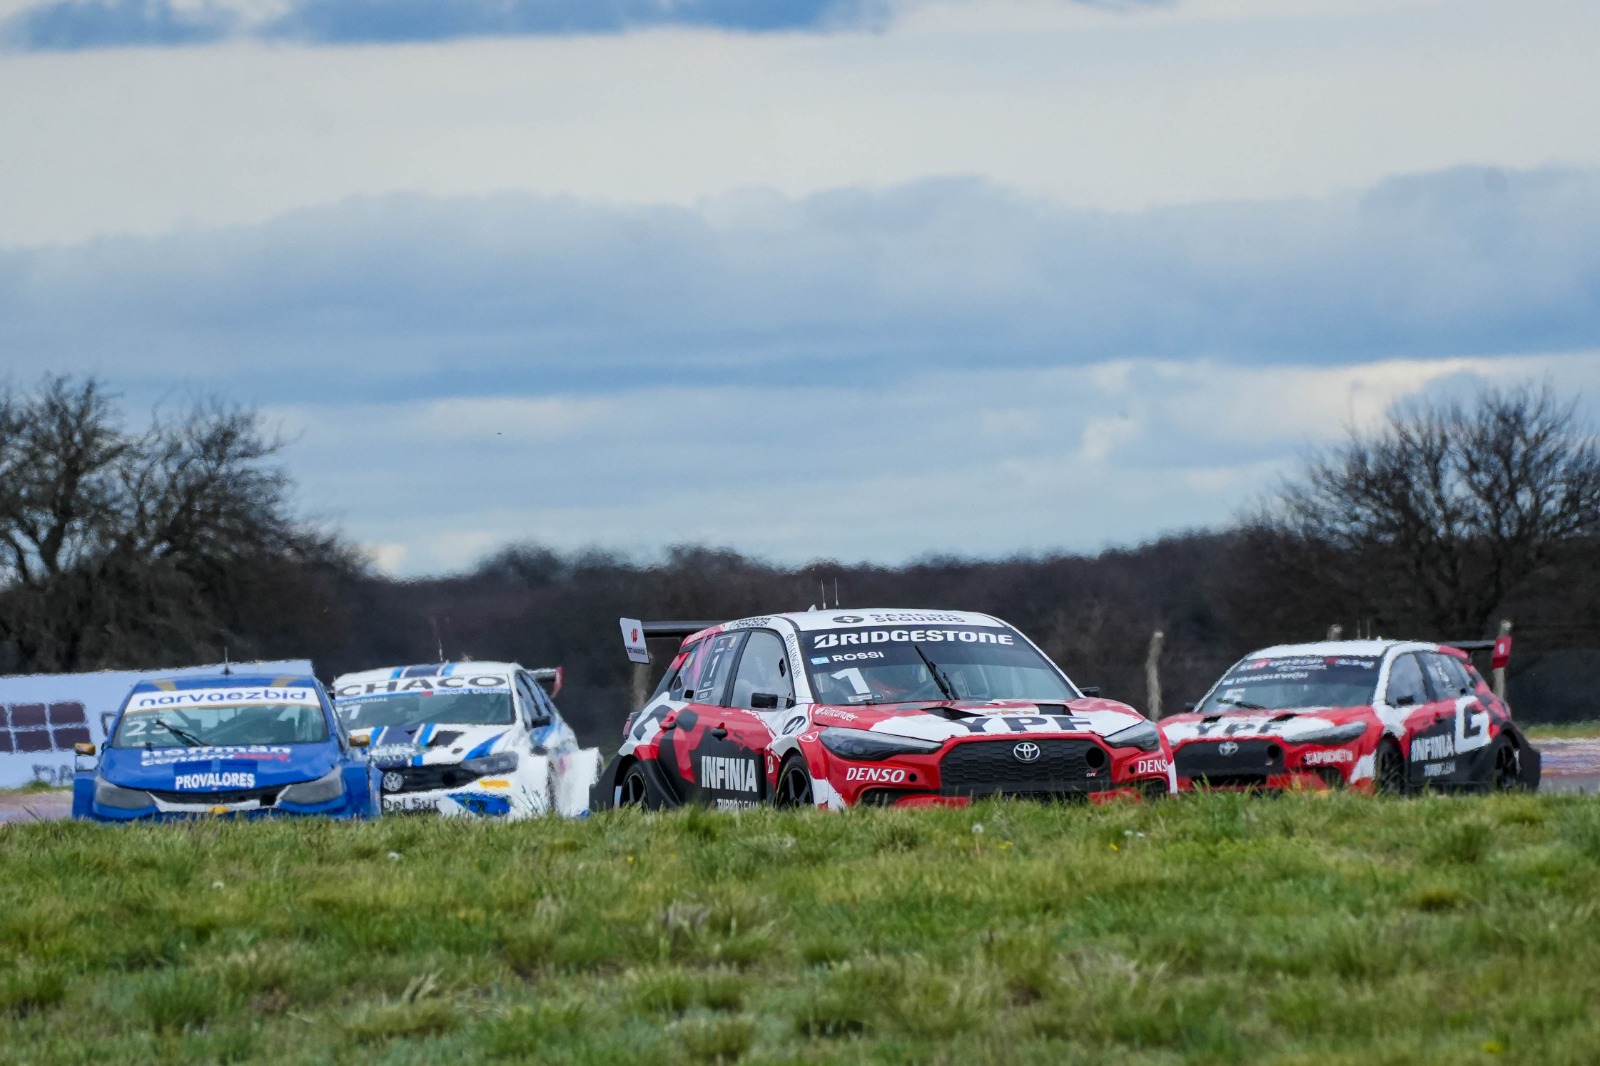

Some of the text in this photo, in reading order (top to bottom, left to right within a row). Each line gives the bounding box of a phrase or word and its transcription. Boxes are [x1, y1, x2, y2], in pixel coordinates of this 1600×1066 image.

[814, 629, 1015, 649] BRIDGESTONE
[832, 651, 885, 663] ROSSI
[336, 676, 507, 697] CHACO
[831, 667, 870, 695] 1
[139, 689, 307, 707] narvaezbid
[954, 716, 1092, 734] YPF
[1197, 722, 1282, 737] YPF
[701, 756, 758, 793] INFINIA
[845, 767, 906, 784] DENSO
[1137, 759, 1169, 774] DENS
[174, 772, 255, 789] PROVALORES
